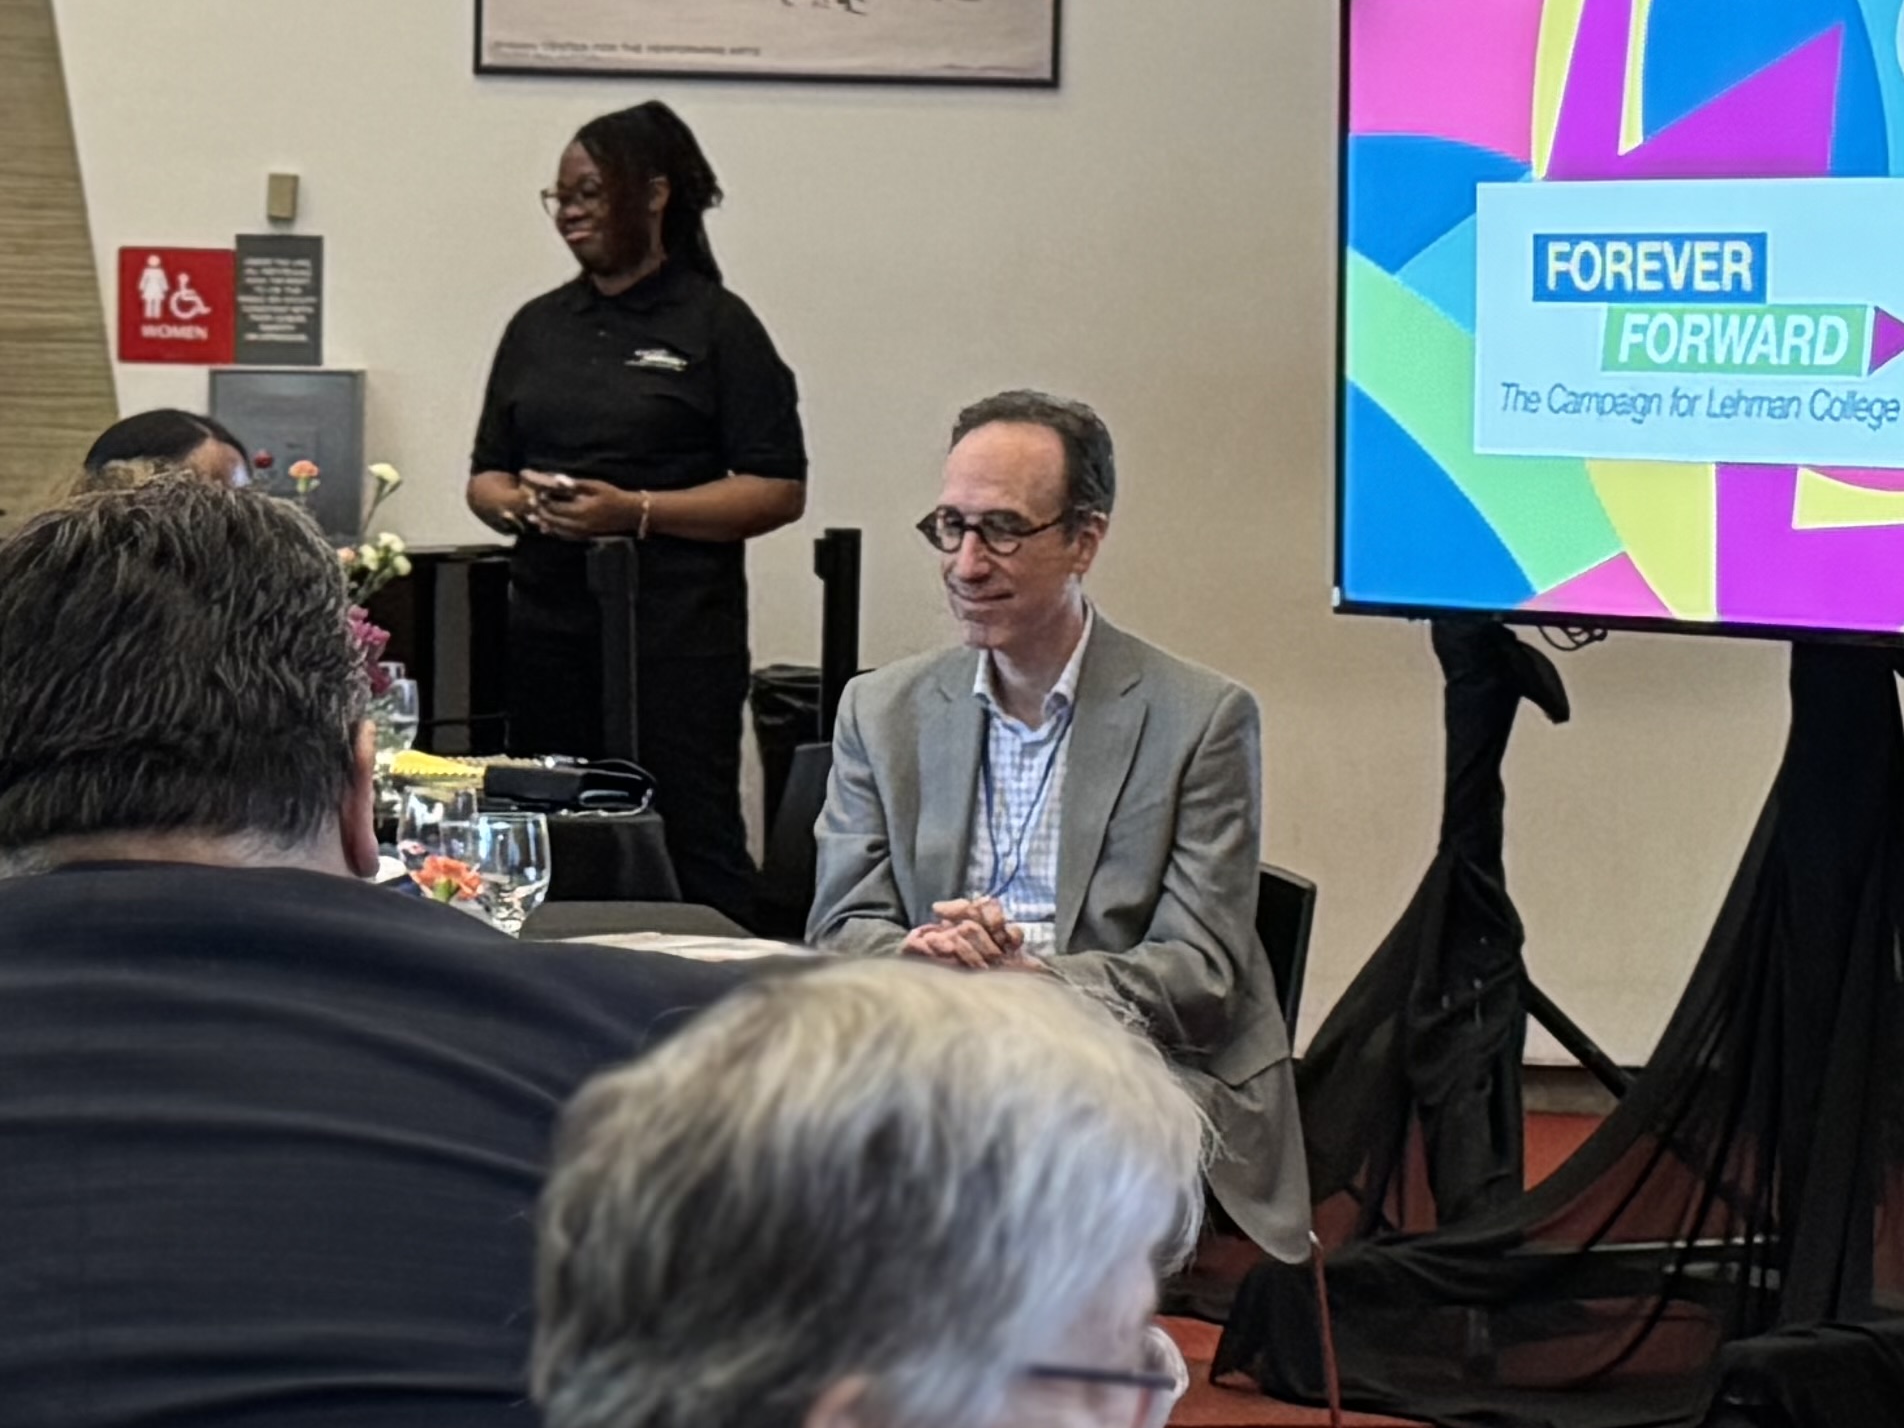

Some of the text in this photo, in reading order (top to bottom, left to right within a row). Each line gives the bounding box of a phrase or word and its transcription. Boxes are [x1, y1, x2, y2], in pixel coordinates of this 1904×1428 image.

[1546, 240, 1754, 293] FOREVER
[141, 324, 209, 341] WOMEN
[1617, 312, 1850, 366] FORWARD
[1501, 382, 1901, 431] The Campaign for Lehman College
